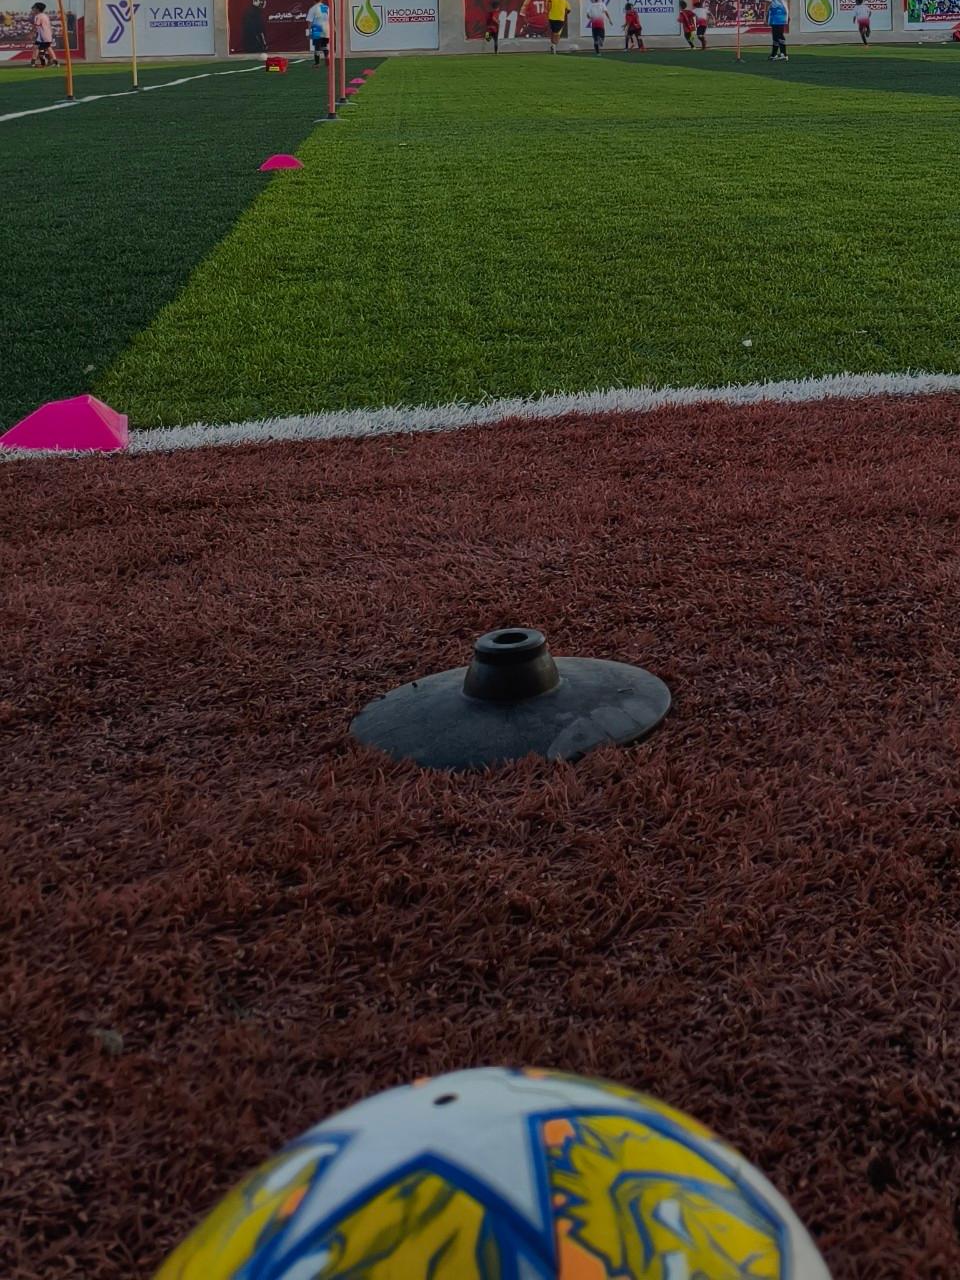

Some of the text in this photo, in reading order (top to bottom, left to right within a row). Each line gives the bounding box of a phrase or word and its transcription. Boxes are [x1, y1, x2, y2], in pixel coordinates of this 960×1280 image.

[149, 7, 207, 20] YARAN
[387, 8, 436, 17] KHODADAD
[498, 10, 518, 39] 11
